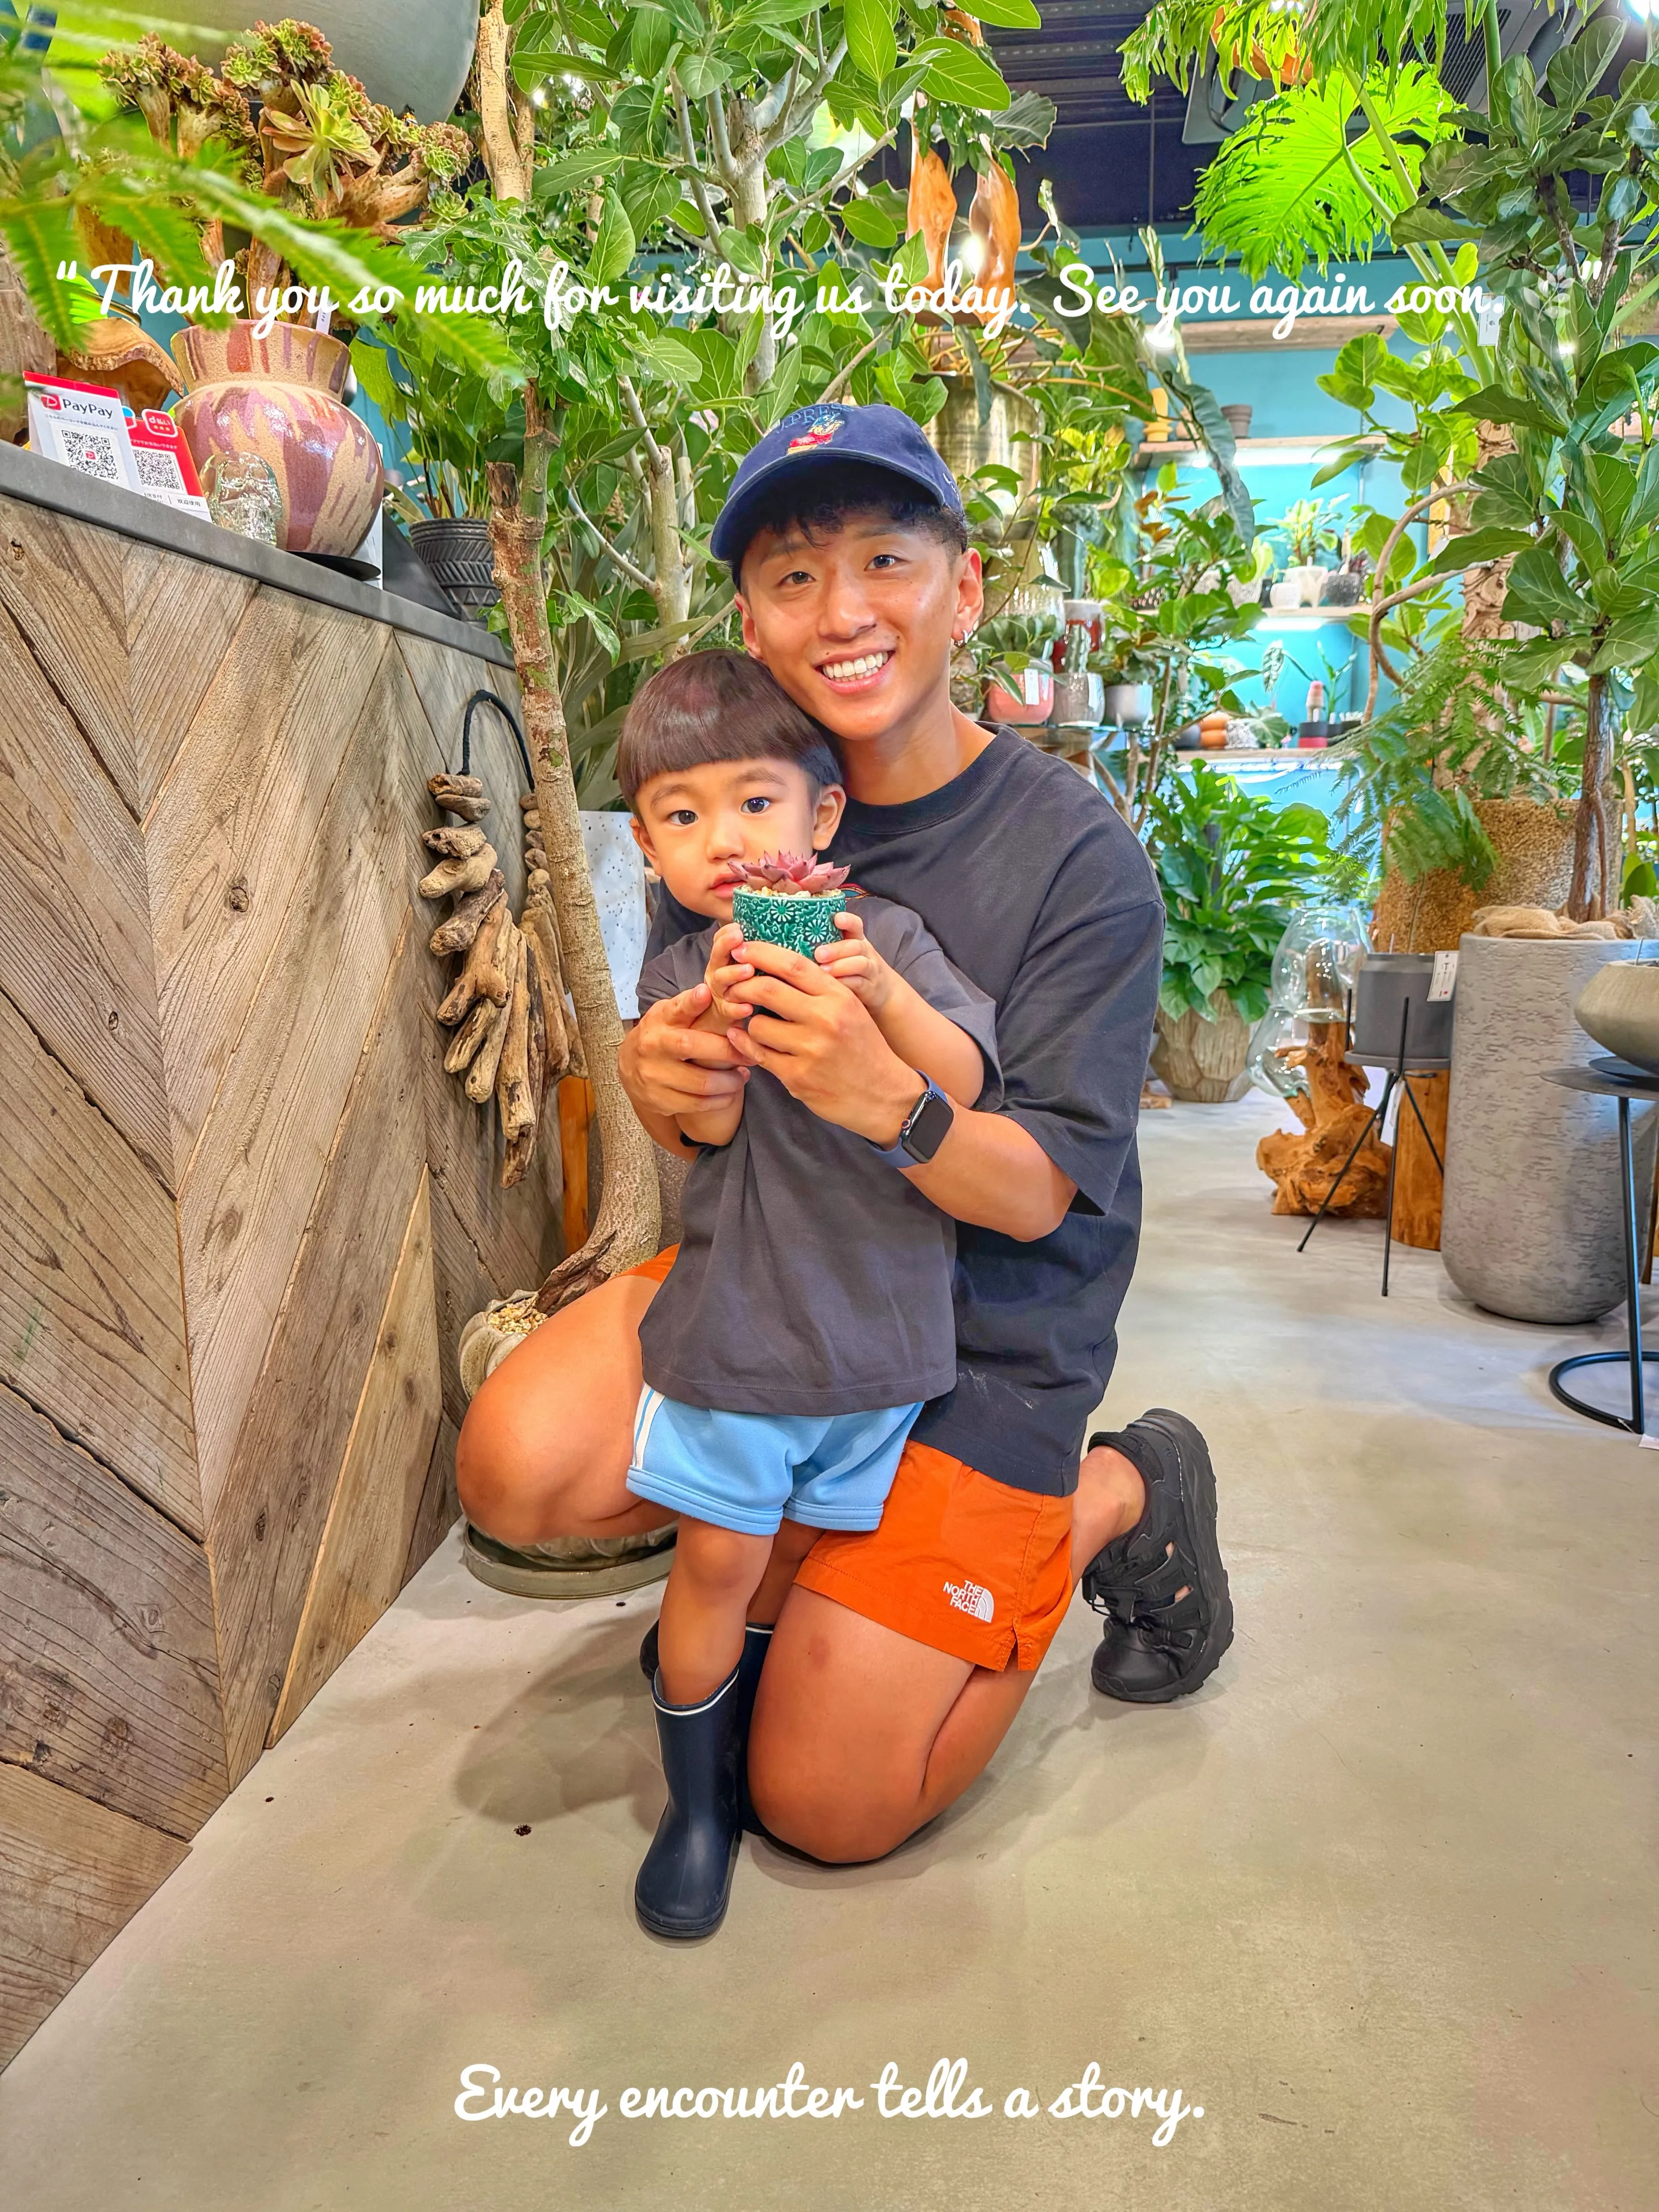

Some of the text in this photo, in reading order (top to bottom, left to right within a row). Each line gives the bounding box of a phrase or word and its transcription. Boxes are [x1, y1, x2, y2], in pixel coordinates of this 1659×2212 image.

[62, 398, 113, 419] PayPay
[942, 1581, 980, 1607] NORTH
[963, 1579, 984, 1595] THE
[949, 1595, 977, 1616] FACE
